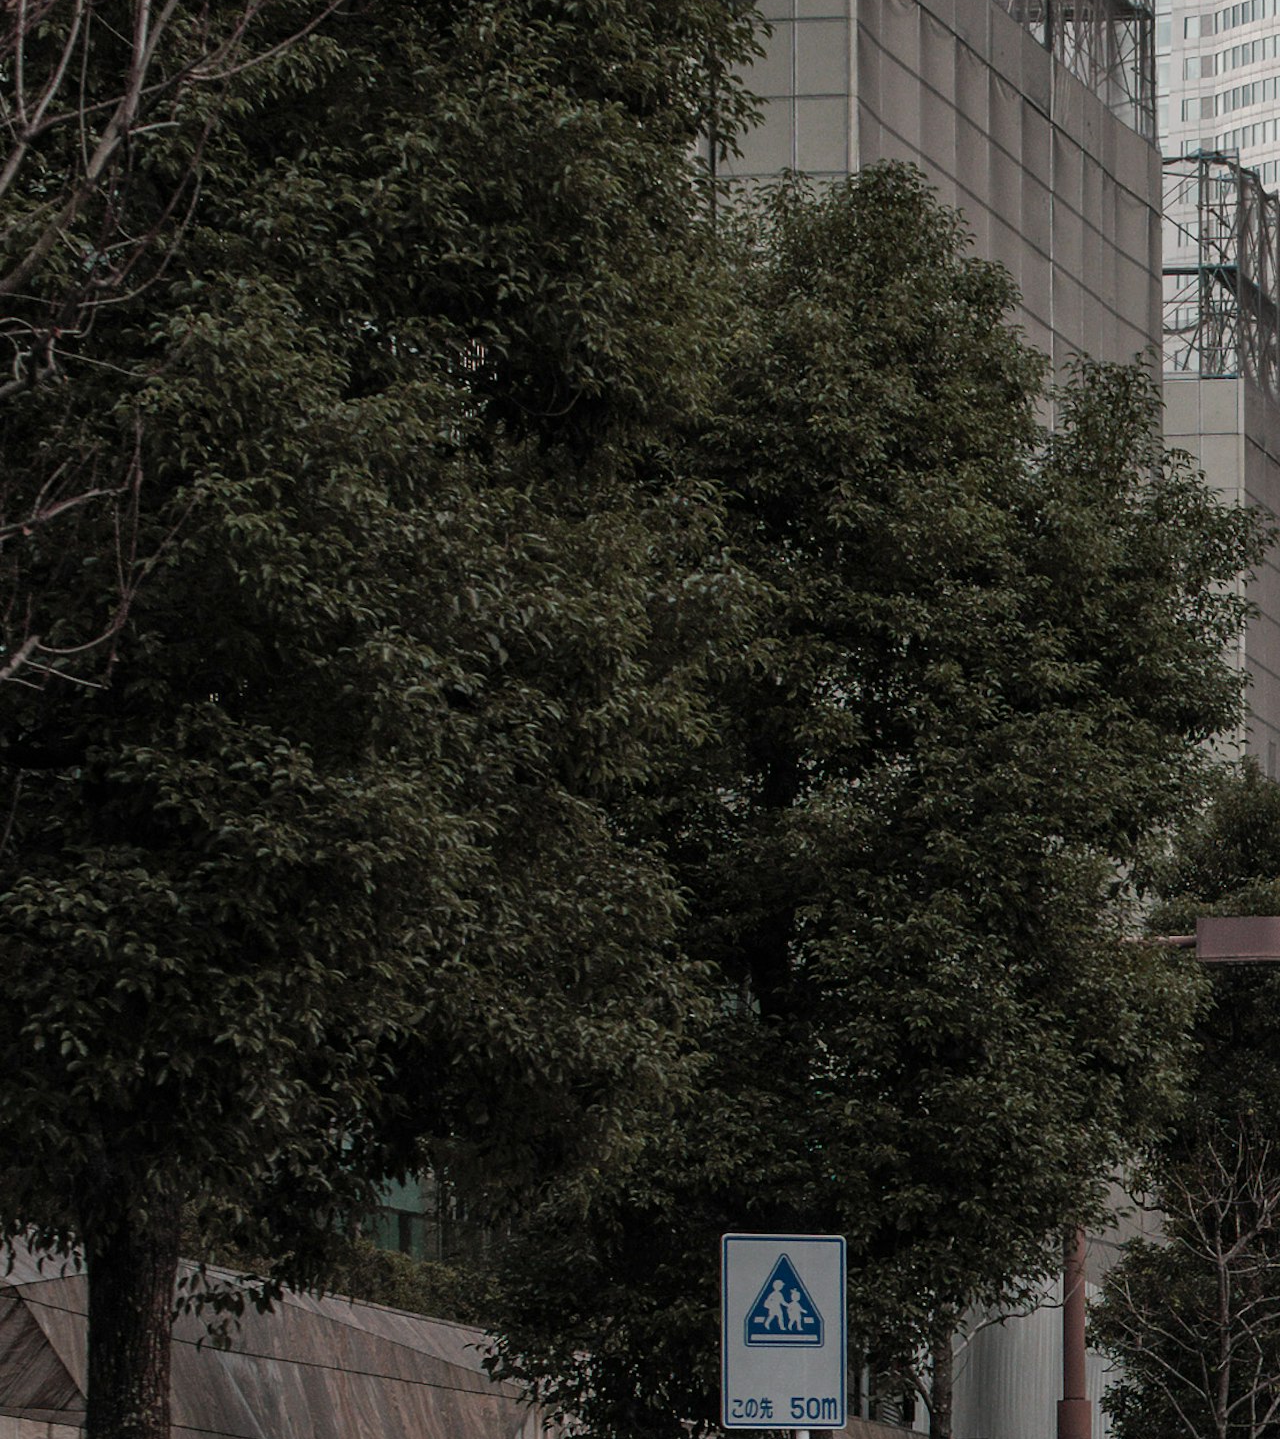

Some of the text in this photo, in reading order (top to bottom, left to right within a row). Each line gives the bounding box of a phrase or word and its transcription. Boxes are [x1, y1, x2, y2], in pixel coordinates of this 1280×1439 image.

[731, 1396, 838, 1420] この先 50m
